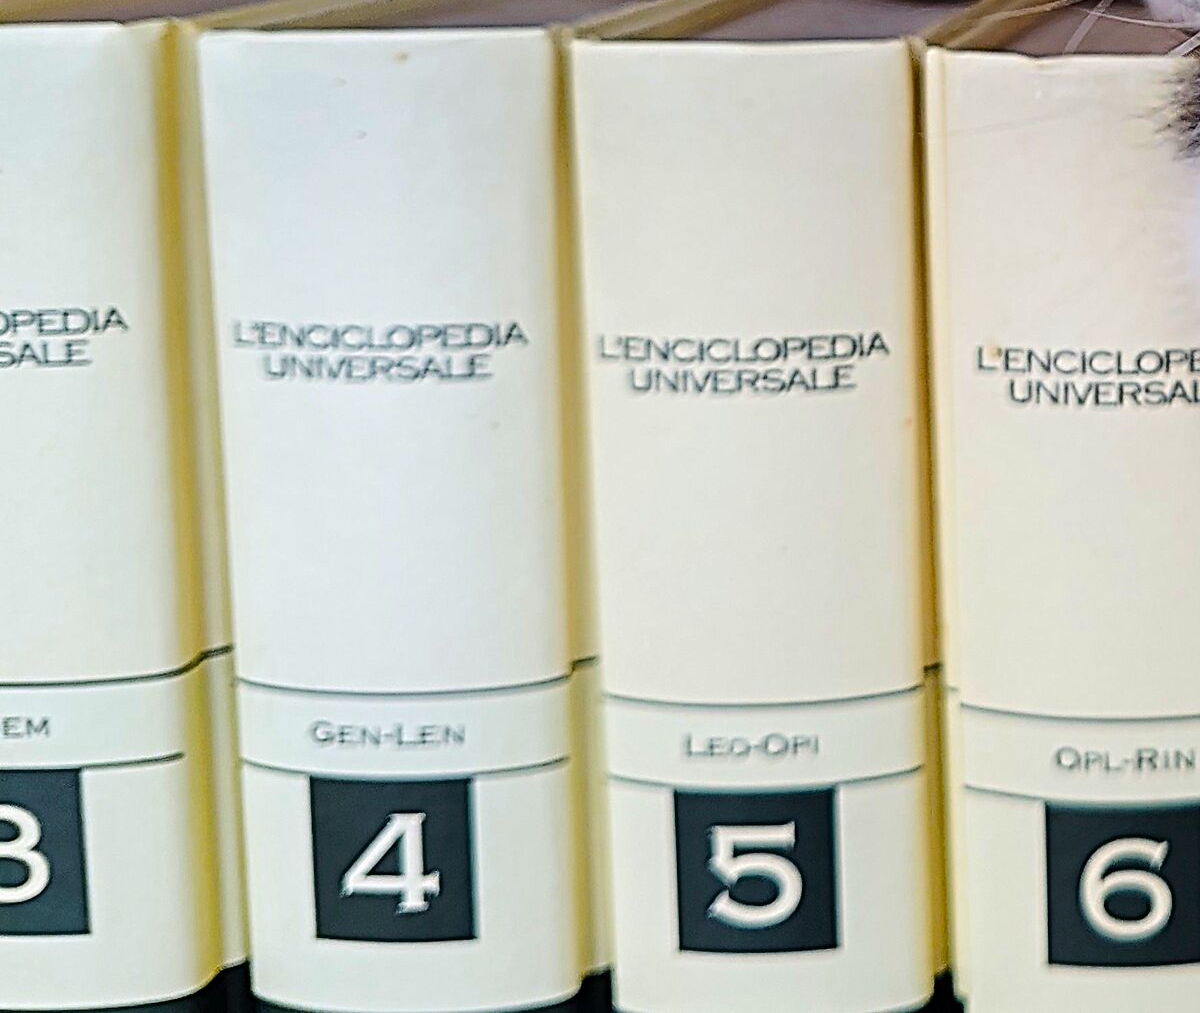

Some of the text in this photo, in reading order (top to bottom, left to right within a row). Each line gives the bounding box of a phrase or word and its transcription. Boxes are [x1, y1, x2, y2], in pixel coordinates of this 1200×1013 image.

[233, 320, 529, 352] L'ENCICLOPEDIA
[597, 331, 891, 363] L'ENCICLOPEDIA
[264, 353, 493, 381] UNIVERSALE
[629, 364, 857, 394] UNIVERSALE
[341, 811, 440, 914] 4
[708, 821, 803, 928] 5
[1079, 836, 1173, 941] 6
